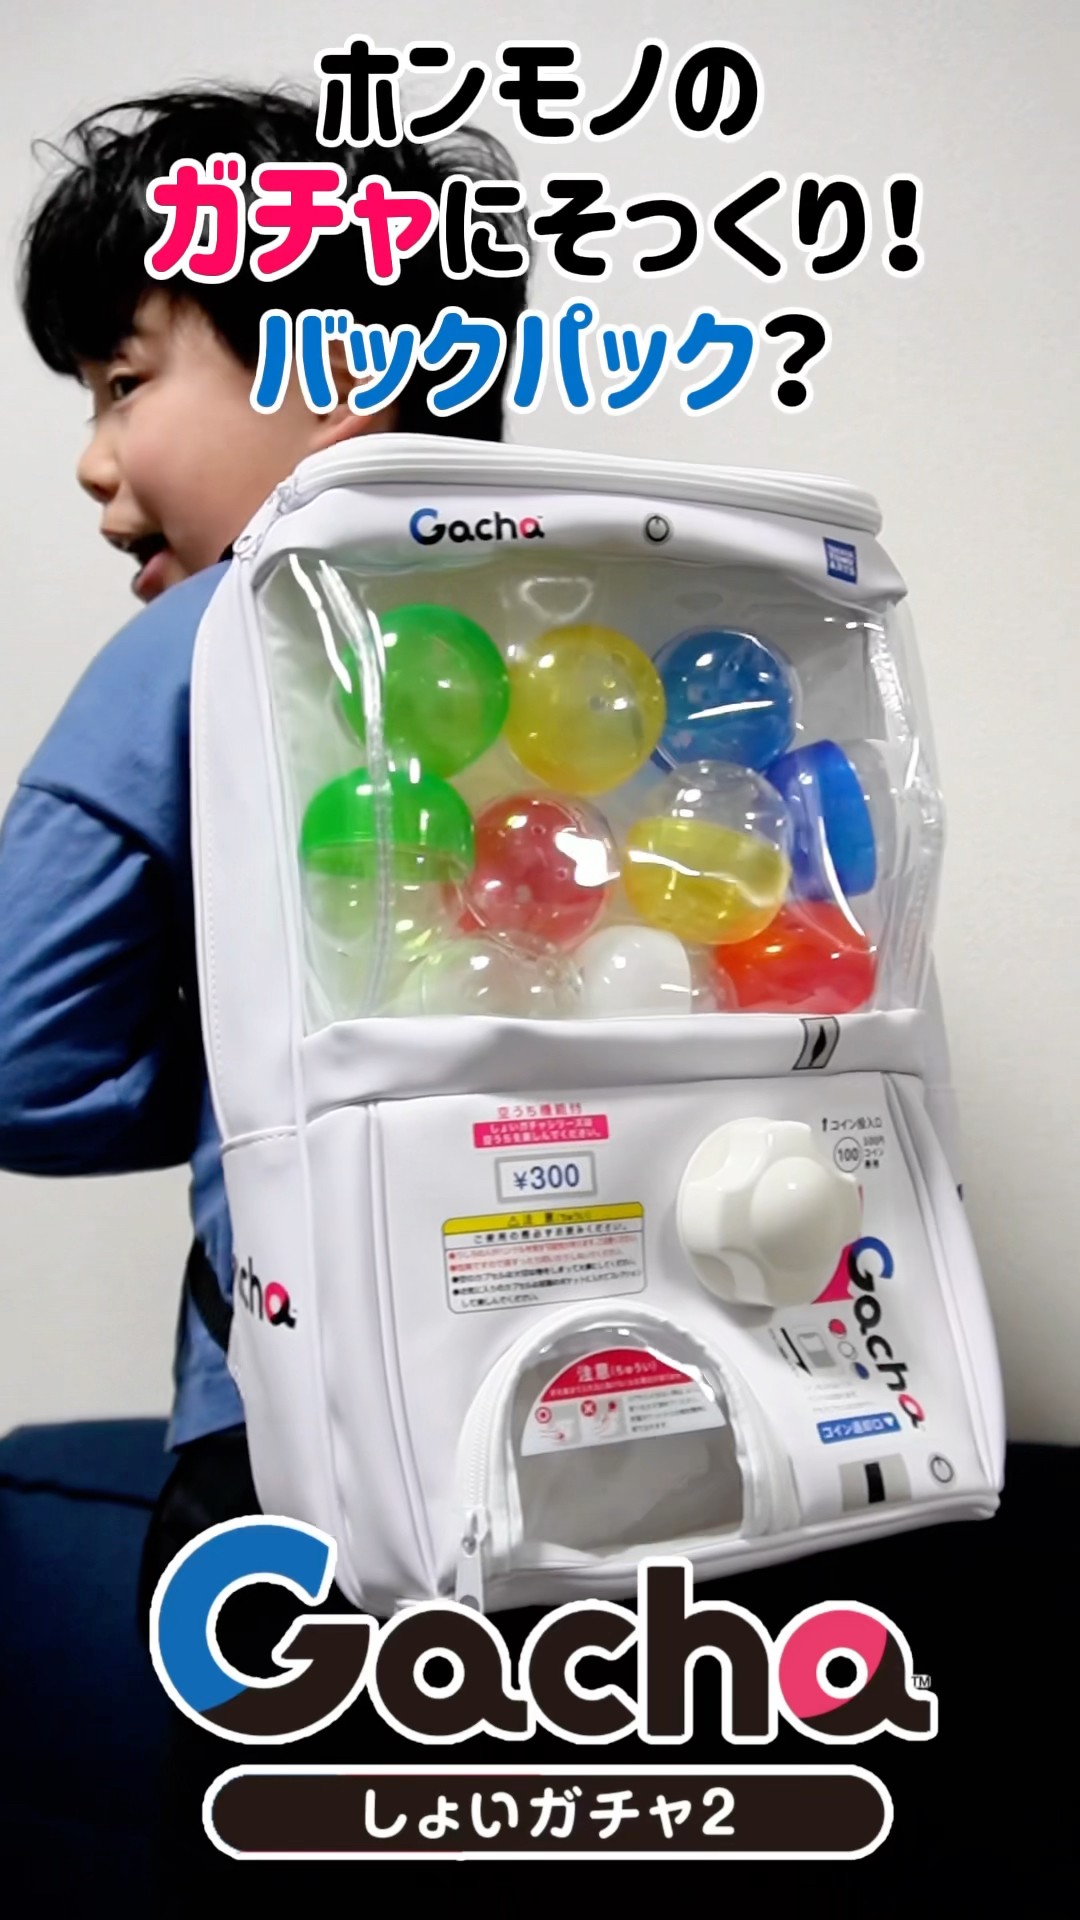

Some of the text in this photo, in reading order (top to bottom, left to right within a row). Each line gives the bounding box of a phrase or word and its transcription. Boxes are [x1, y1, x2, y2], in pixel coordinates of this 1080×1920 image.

[409, 508, 545, 545] Gacha
[838, 1147, 860, 1162] 100
[513, 1163, 580, 1190] ¥300
[238, 1256, 297, 1330] cha
[847, 1236, 926, 1429] Gacha
